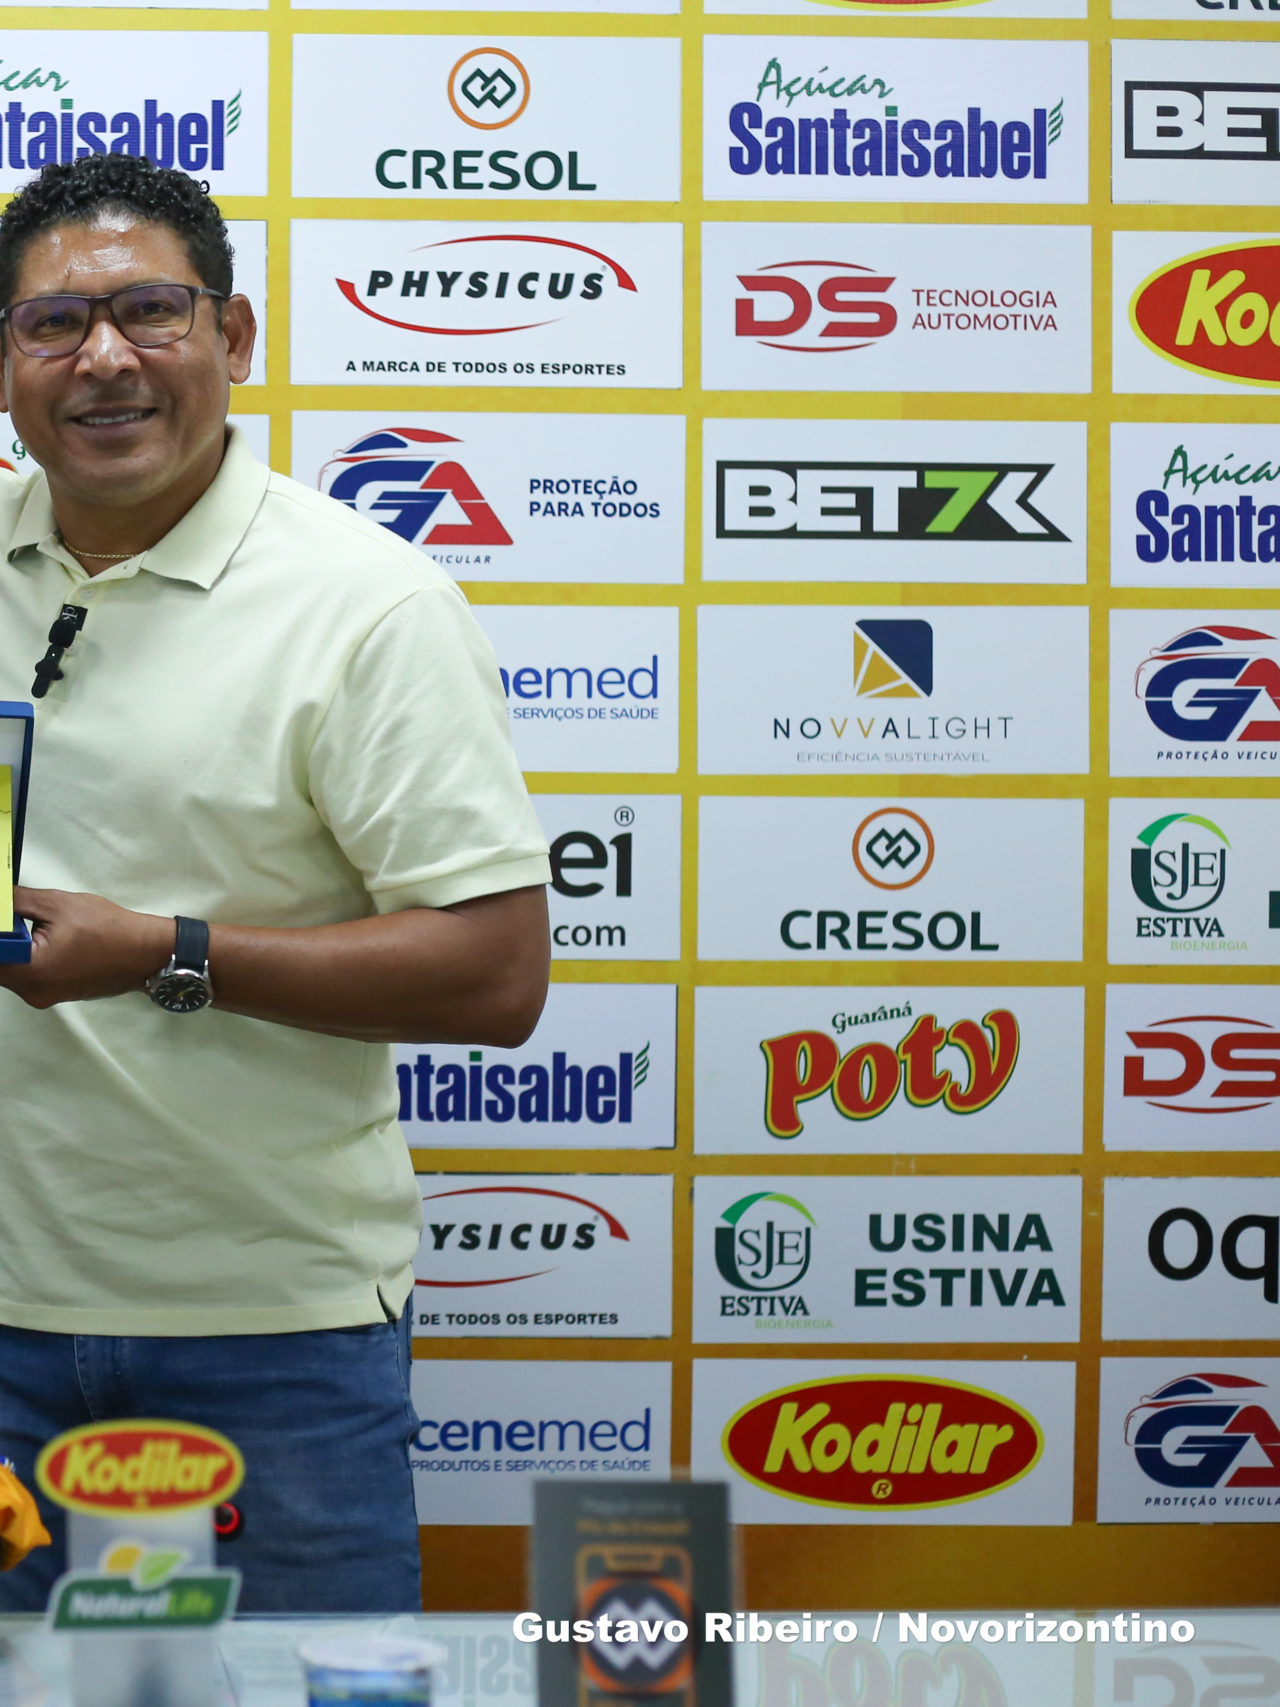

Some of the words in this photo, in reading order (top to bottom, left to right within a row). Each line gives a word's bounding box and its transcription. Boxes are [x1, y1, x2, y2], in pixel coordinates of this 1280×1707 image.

[757, 57, 894, 108] Açúcar
[729, 102, 1047, 179] Santaisabel
[376, 149, 597, 191] CRESOL
[367, 270, 604, 300] PHYSICUS
[912, 289, 1057, 308] TECNOLOGIA
[735, 275, 897, 338] DS
[912, 313, 1057, 331] AUTOMOTIVA
[346, 361, 356, 371] A
[363, 361, 420, 372] MARCA
[426, 362, 446, 372] DE
[452, 362, 507, 373] TODOS
[513, 363, 535, 374] OS
[541, 363, 625, 375] ESPORTES
[1163, 445, 1280, 495] Açúca
[530, 476, 637, 500] PROTEÇÃO
[530, 501, 584, 517] PARA
[591, 502, 660, 518] TODOS
[500, 655, 658, 699] emed
[513, 708, 584, 721] SERVIÇOS
[588, 708, 606, 719] DE
[610, 708, 658, 719] SAÚDE
[774, 717, 1013, 739] NOVVALIGHT
[796, 750, 880, 762] EFICIÊNCIA
[885, 750, 990, 763] SUSTENTÁVEL
[1157, 750, 1228, 762] PROTEÇÃO
[1237, 752, 1277, 760] VEICU
[780, 910, 999, 951] CRESOL
[1136, 917, 1224, 937] ESTIVA
[1170, 940, 1248, 952] BIOENERGIA
[761, 1009, 1019, 1140] Poty
[1123, 1031, 1280, 1097] DS
[397, 1052, 632, 1123] ntaisabel
[429, 1223, 597, 1251] YSICUS
[869, 1213, 1053, 1252] USINA
[854, 1268, 1066, 1307] ESTIVA
[420, 1314, 440, 1325] DE
[445, 1314, 501, 1325] TODOS
[506, 1313, 528, 1325] OS
[534, 1313, 618, 1325] ESPORTES
[720, 1296, 809, 1316] ESTIVA
[755, 1319, 833, 1329] BIOENERGIA
[414, 1407, 651, 1453] cenemed
[763, 1402, 1014, 1475] Kodilar
[60, 1440, 226, 1495] Kodilar
[411, 1460, 490, 1472] PRODUTOS
[494, 1460, 502, 1472] E
[505, 1460, 576, 1475] SERVIÇOS
[580, 1460, 598, 1471] DE
[602, 1457, 651, 1471] SAÚDE
[1145, 1495, 1216, 1508] PROTEÇÃO
[1225, 1498, 1280, 1506] VEICULA
